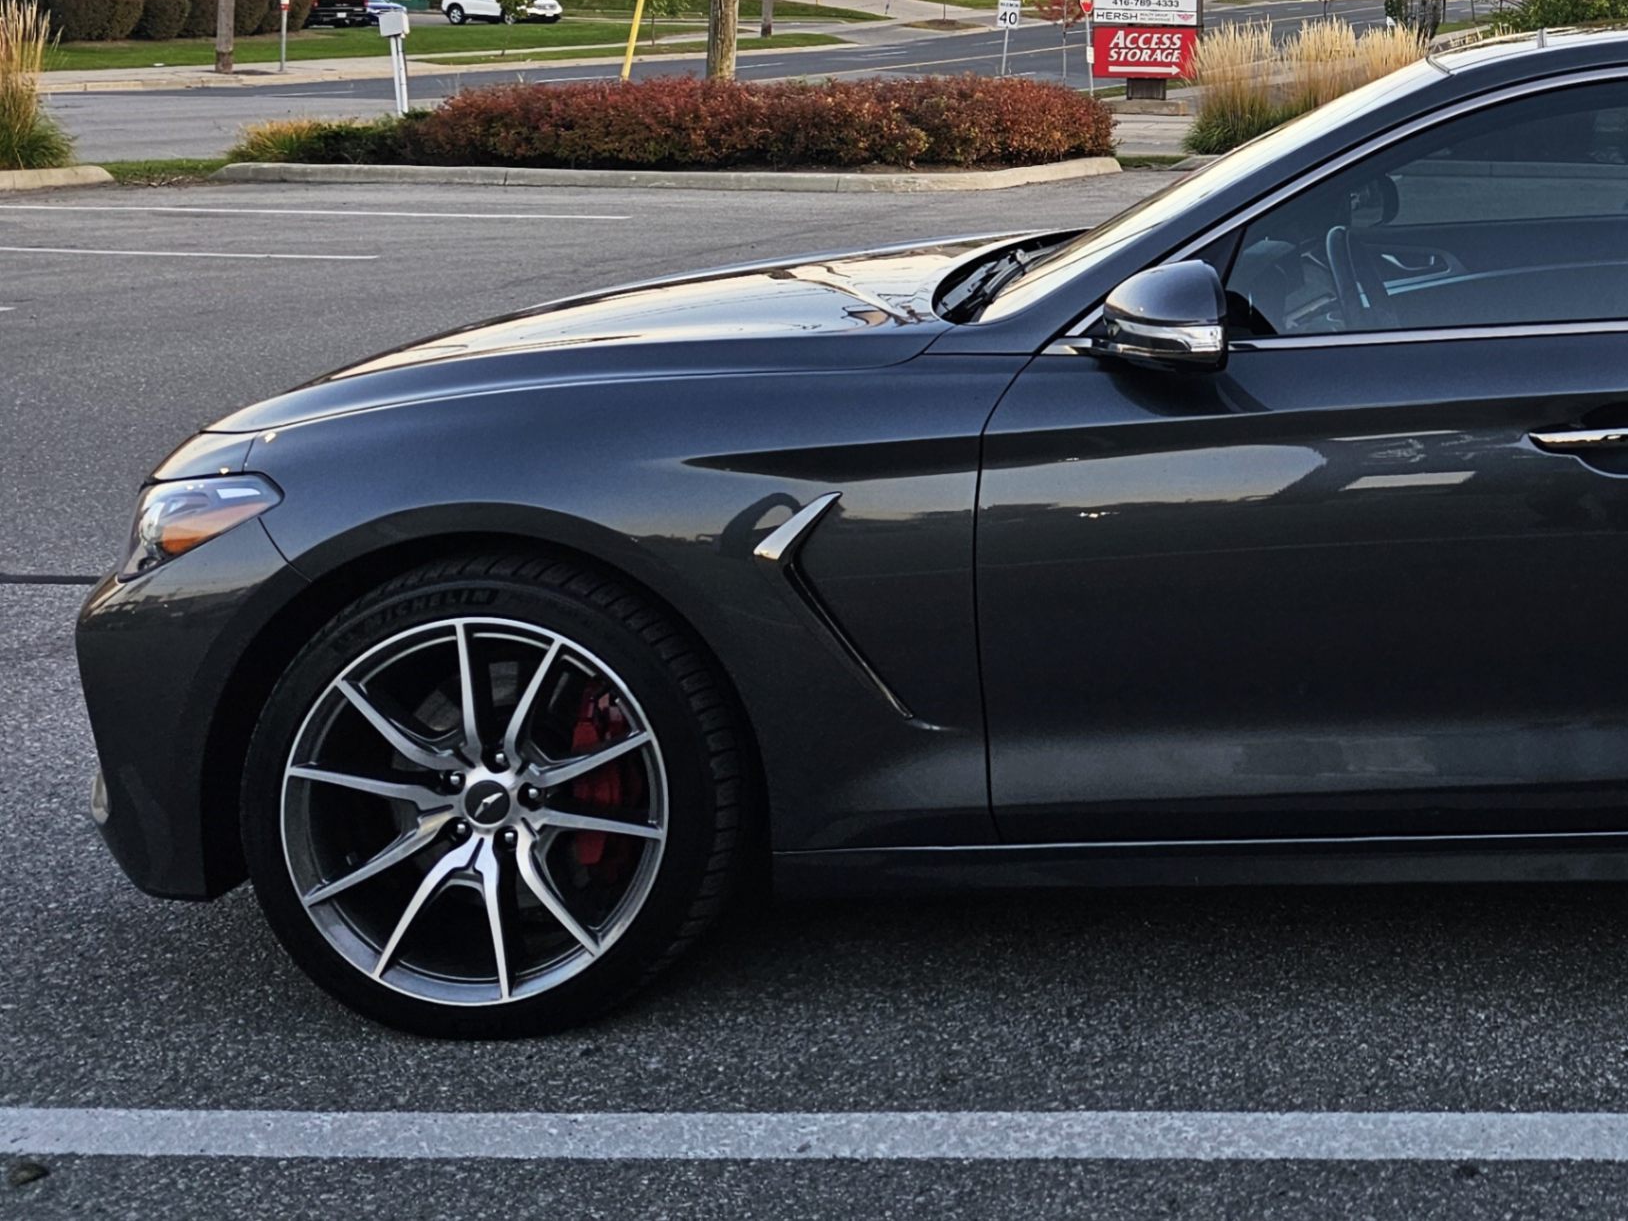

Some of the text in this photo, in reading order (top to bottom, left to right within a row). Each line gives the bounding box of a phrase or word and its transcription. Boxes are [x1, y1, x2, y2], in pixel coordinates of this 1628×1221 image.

[999, 11, 1017, 25] 40
[1096, 11, 1138, 21] HERSH
[1107, 48, 1182, 62] STORAGE
